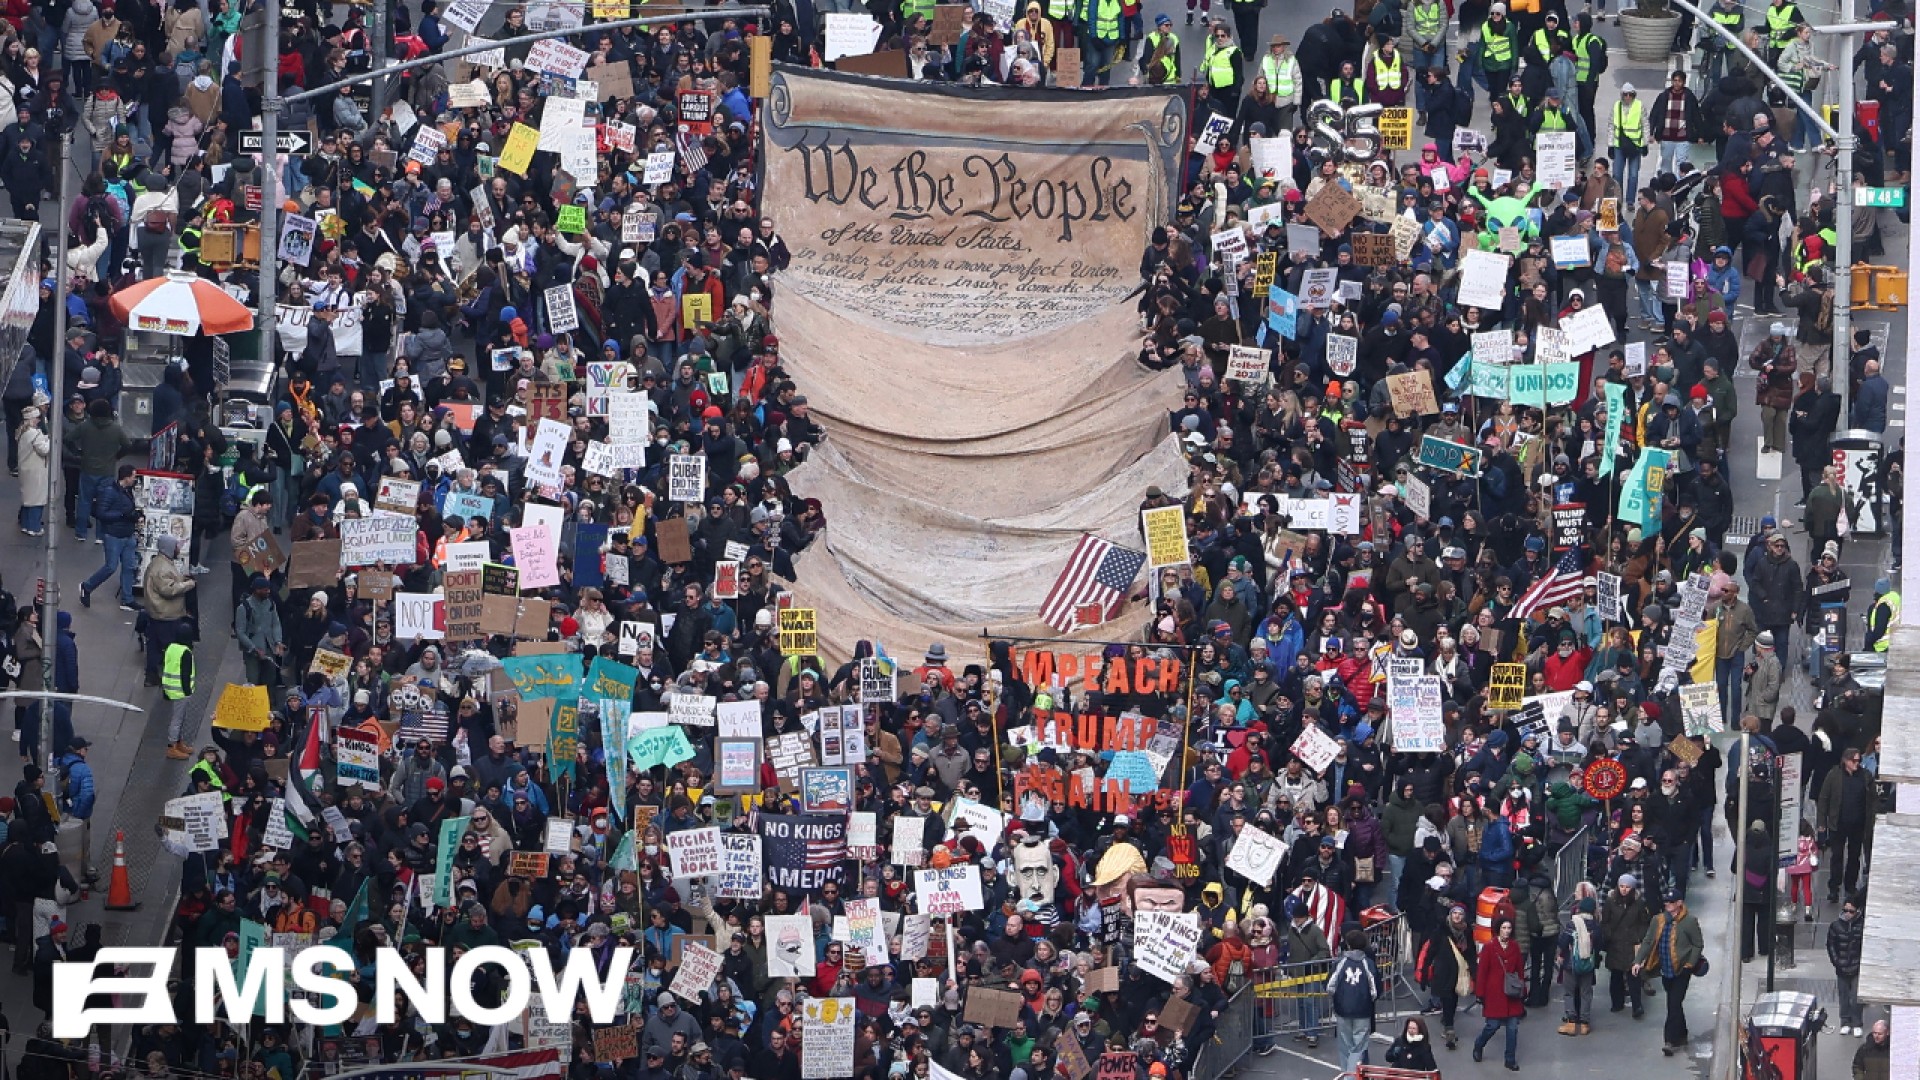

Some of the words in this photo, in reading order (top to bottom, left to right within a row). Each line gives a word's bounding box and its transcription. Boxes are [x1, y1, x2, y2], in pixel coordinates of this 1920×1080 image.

[785, 129, 889, 212] We
[889, 149, 964, 220] the
[962, 152, 1137, 243] People
[1868, 190, 1876, 203] W
[1878, 190, 1891, 204] 48
[821, 221, 851, 247] of
[849, 222, 883, 245] the
[890, 227, 957, 256] United
[1354, 237, 1368, 246] NO
[1373, 237, 1393, 247] ICE
[1354, 247, 1368, 255] NO
[821, 245, 870, 267] order
[876, 251, 894, 268] to
[892, 251, 940, 274] form
[943, 260, 954, 271] a
[955, 260, 992, 273] more
[989, 257, 1068, 281] perfect
[1355, 256, 1369, 265] NO
[1016, 277, 1084, 294] domestic
[1515, 374, 1575, 393] UNIDOS
[531, 398, 562, 419] 13
[672, 464, 701, 479] CUBA!
[688, 479, 701, 489] THE
[1289, 500, 1307, 512] NO
[1307, 511, 1325, 520] ICE
[1553, 509, 1585, 519] TRUMP
[344, 521, 367, 535] WE
[369, 520, 391, 532] ARE
[1556, 518, 1582, 527] MUST
[1563, 528, 1577, 536] GO
[449, 589, 482, 603] REIGN
[450, 606, 463, 620] ON
[464, 603, 483, 618] OUR
[782, 611, 800, 621] STOP
[801, 610, 813, 620] THE
[783, 620, 814, 631] WAR
[1008, 646, 1181, 695] IMPEACH
[1411, 666, 1420, 674] UP
[1493, 665, 1511, 675] STOP
[1511, 665, 1524, 675] THE
[1491, 675, 1523, 685] WAR
[720, 712, 738, 725] WE
[741, 710, 760, 724] ARE
[1032, 708, 1158, 751] TRUMP
[765, 821, 789, 838] NO
[794, 823, 842, 840] KINGS
[670, 831, 715, 849] REGIME
[683, 846, 717, 856] CHANGE
[680, 860, 719, 874] HOME
[923, 870, 937, 882] NO
[937, 867, 967, 881] KINGS
[937, 880, 952, 892] OR
[928, 892, 961, 904] DRAMA
[1098, 1055, 1138, 1073] POWER
